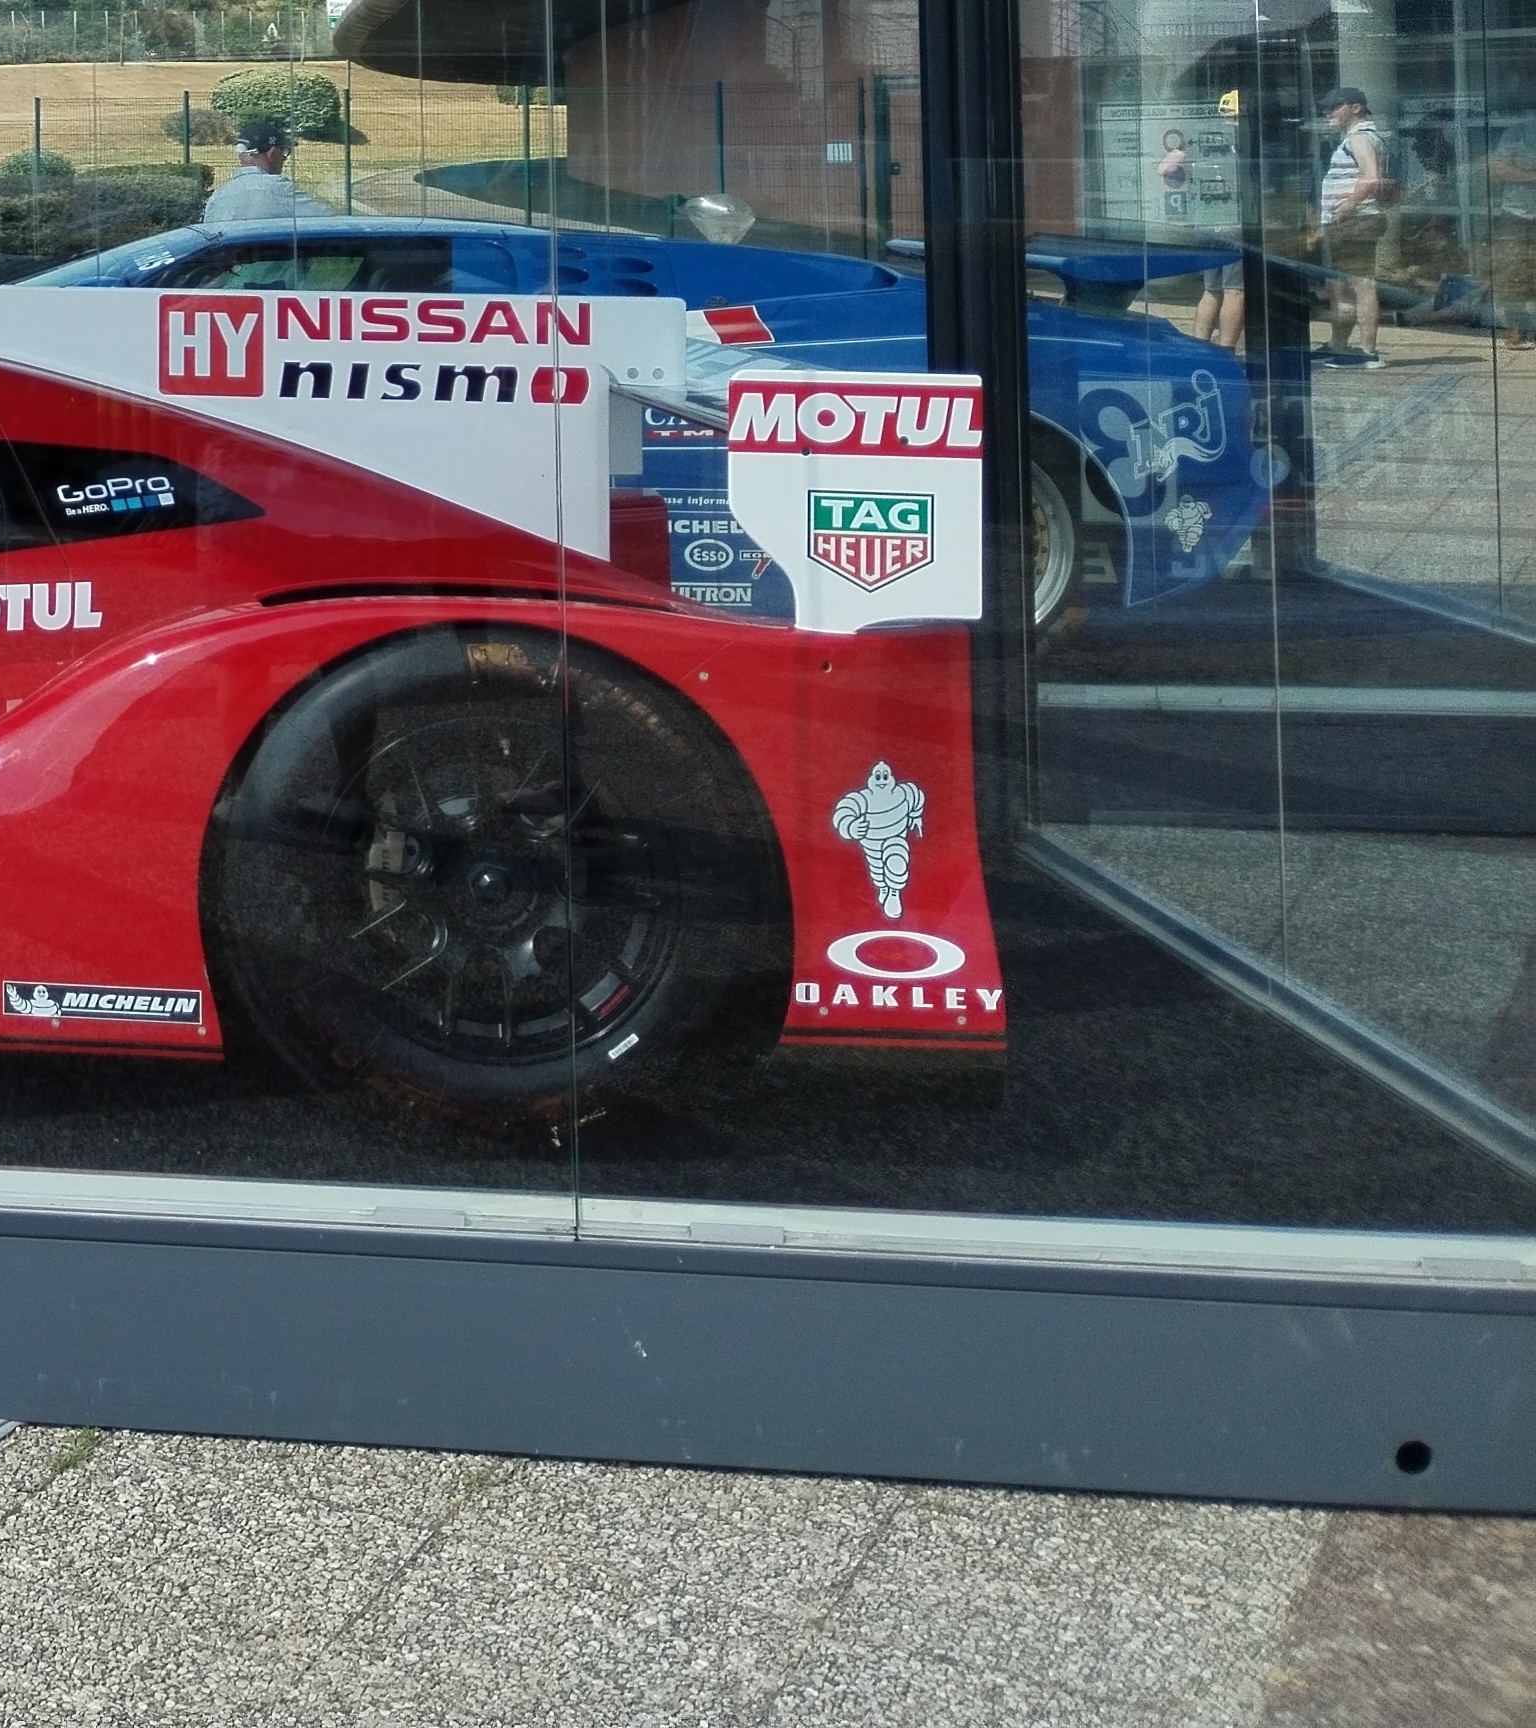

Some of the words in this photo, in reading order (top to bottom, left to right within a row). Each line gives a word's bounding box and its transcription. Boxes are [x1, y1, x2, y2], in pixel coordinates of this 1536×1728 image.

[168, 311, 259, 378] HY
[276, 297, 592, 346] NISSAN
[278, 361, 591, 404] nismo
[729, 392, 982, 448] MOTUL
[57, 476, 171, 503] GoPro
[669, 520, 745, 534] ICHEL
[820, 499, 921, 532] TAG
[817, 535, 925, 583] HEUER
[61, 992, 197, 1013] MICHELIN
[795, 982, 1003, 1011] OAKLEY
